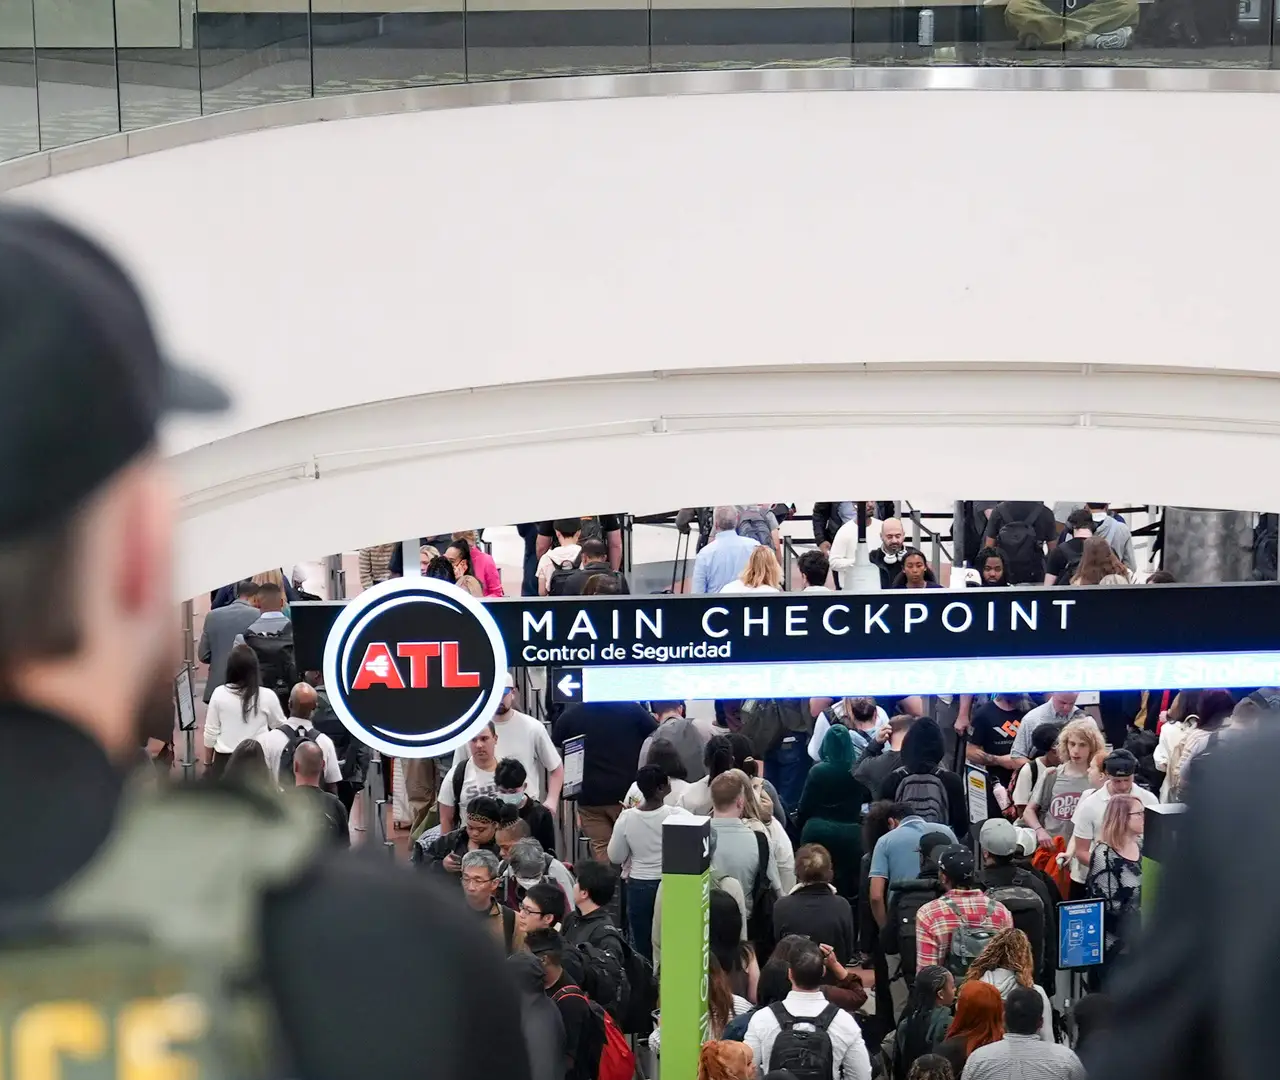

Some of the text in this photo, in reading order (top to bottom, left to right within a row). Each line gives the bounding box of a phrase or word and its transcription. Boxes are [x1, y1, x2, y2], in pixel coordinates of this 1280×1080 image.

[522, 599, 1076, 641] MAIN CHECKPOINT
[352, 640, 480, 690] ATL
[522, 640, 732, 663] Control de Seguridad
[1050, 796, 1077, 818] Pepp
[1064, 795, 1080, 807] Dr
[700, 907, 711, 1002] Gates
